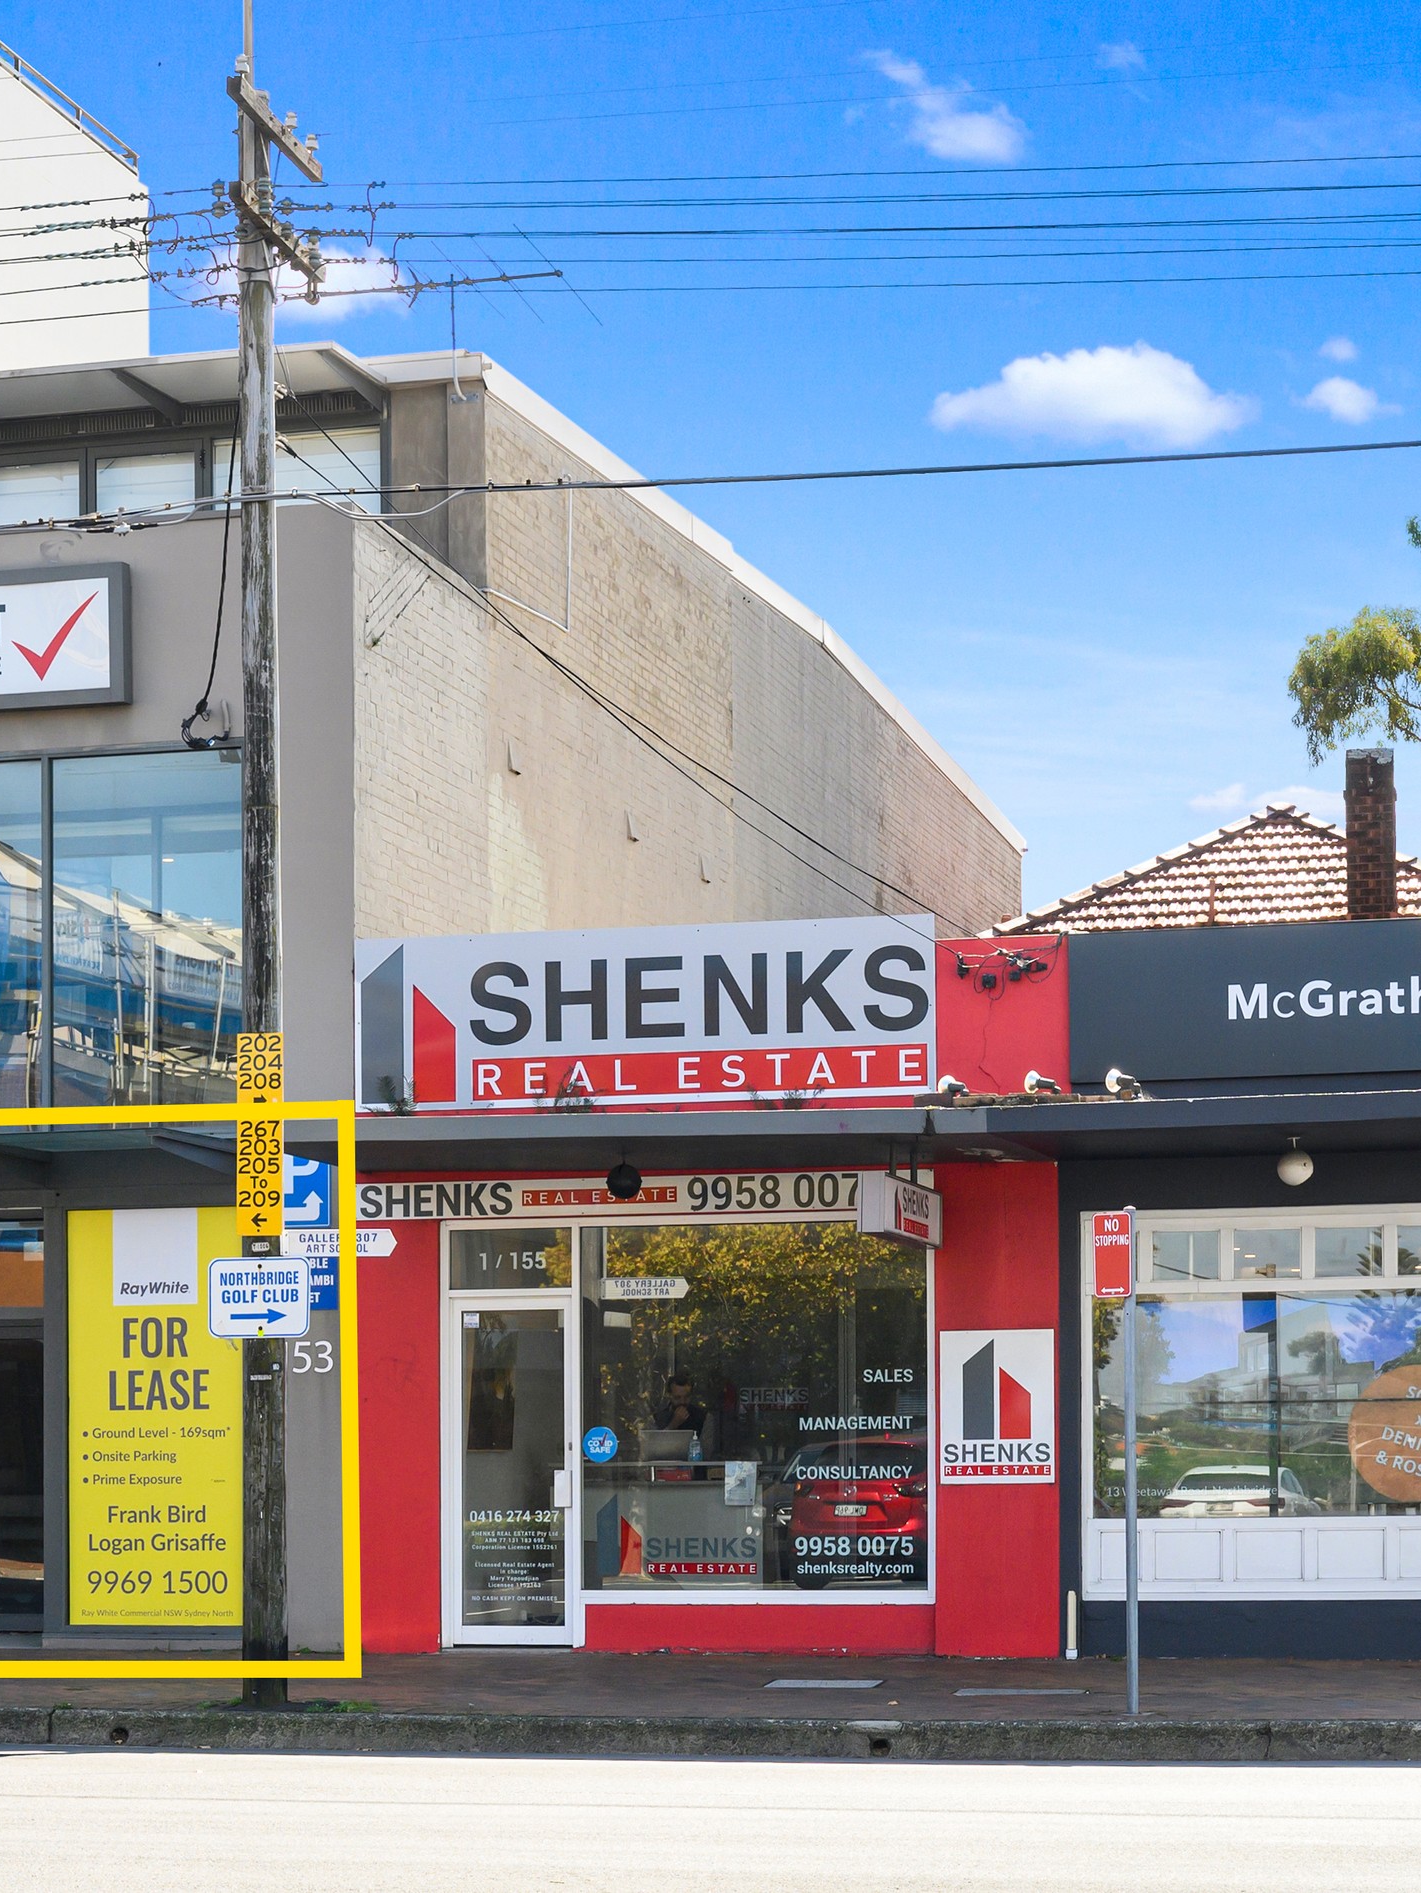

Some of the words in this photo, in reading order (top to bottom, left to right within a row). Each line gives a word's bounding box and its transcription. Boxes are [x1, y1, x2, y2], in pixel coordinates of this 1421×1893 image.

[469, 944, 930, 1046] SHENKS
[239, 1035, 281, 1053] 202
[238, 1054, 283, 1071] 204
[477, 1058, 637, 1096] REAL
[678, 1048, 923, 1090] ESTATE
[239, 1072, 281, 1090] 208
[240, 1121, 280, 1138] 267
[239, 1139, 280, 1156] 203
[238, 1157, 280, 1174] 205
[249, 1176, 268, 1189] To
[238, 1191, 280, 1208] 209
[360, 1182, 513, 1218] SHENKS
[523, 1192, 579, 1204] REAL
[592, 1188, 676, 1203] ESATE
[687, 1174, 781, 1211] 9958
[793, 1173, 858, 1208] 007
[902, 1186, 929, 1219] SHENKS
[1104, 1218, 1120, 1232] NO
[299, 1233, 340, 1243] GALLE
[356, 1232, 378, 1242] 307
[1095, 1234, 1129, 1247] STOPPING
[305, 1244, 326, 1253] ART
[329, 1243, 369, 1253] SCOL
[479, 1252, 487, 1270] 1
[509, 1251, 547, 1270] 155
[219, 1270, 300, 1287] NORTHBRIDGE
[221, 1289, 258, 1304] GOLF
[262, 1288, 299, 1303] CLUB
[122, 1316, 189, 1358] FOR
[862, 1368, 914, 1383] SALES
[109, 1369, 210, 1411] LEASE
[740, 1388, 809, 1402] SHENKS
[798, 1416, 913, 1431] MANAGEMENT
[92, 1427, 136, 1438] Ground
[138, 1427, 169, 1438] Level
[92, 1450, 130, 1462] Onsite
[133, 1450, 177, 1464] Parking
[943, 1442, 1051, 1463] SHENKS
[1375, 1450, 1388, 1465] &
[796, 1464, 913, 1480] CONSULTANCY
[945, 1466, 984, 1475] REAL
[992, 1465, 1050, 1475] ESTATE
[92, 1474, 126, 1485] Prime
[129, 1474, 183, 1487] Exposure
[1106, 1486, 1120, 1497] 13
[107, 1505, 161, 1523] Frank
[167, 1505, 206, 1523] Bird
[469, 1510, 503, 1522] 0416
[506, 1510, 531, 1522] 274
[534, 1510, 560, 1522] 327
[88, 1533, 145, 1555] Logan
[151, 1533, 227, 1551] Grisaffe
[646, 1537, 757, 1559] SHENKS
[794, 1536, 851, 1557] 9958
[857, 1536, 914, 1557] 0075
[648, 1564, 688, 1573] REAL
[697, 1564, 757, 1573] ESTATE
[796, 1561, 915, 1577] shenksrealty.com
[87, 1570, 152, 1594] 9969
[163, 1570, 228, 1594] 1500
[81, 1609, 94, 1619] Ray
[96, 1609, 118, 1617] White
[119, 1609, 162, 1617] Commercial
[184, 1609, 210, 1619] Sydney
[212, 1609, 234, 1617] North
